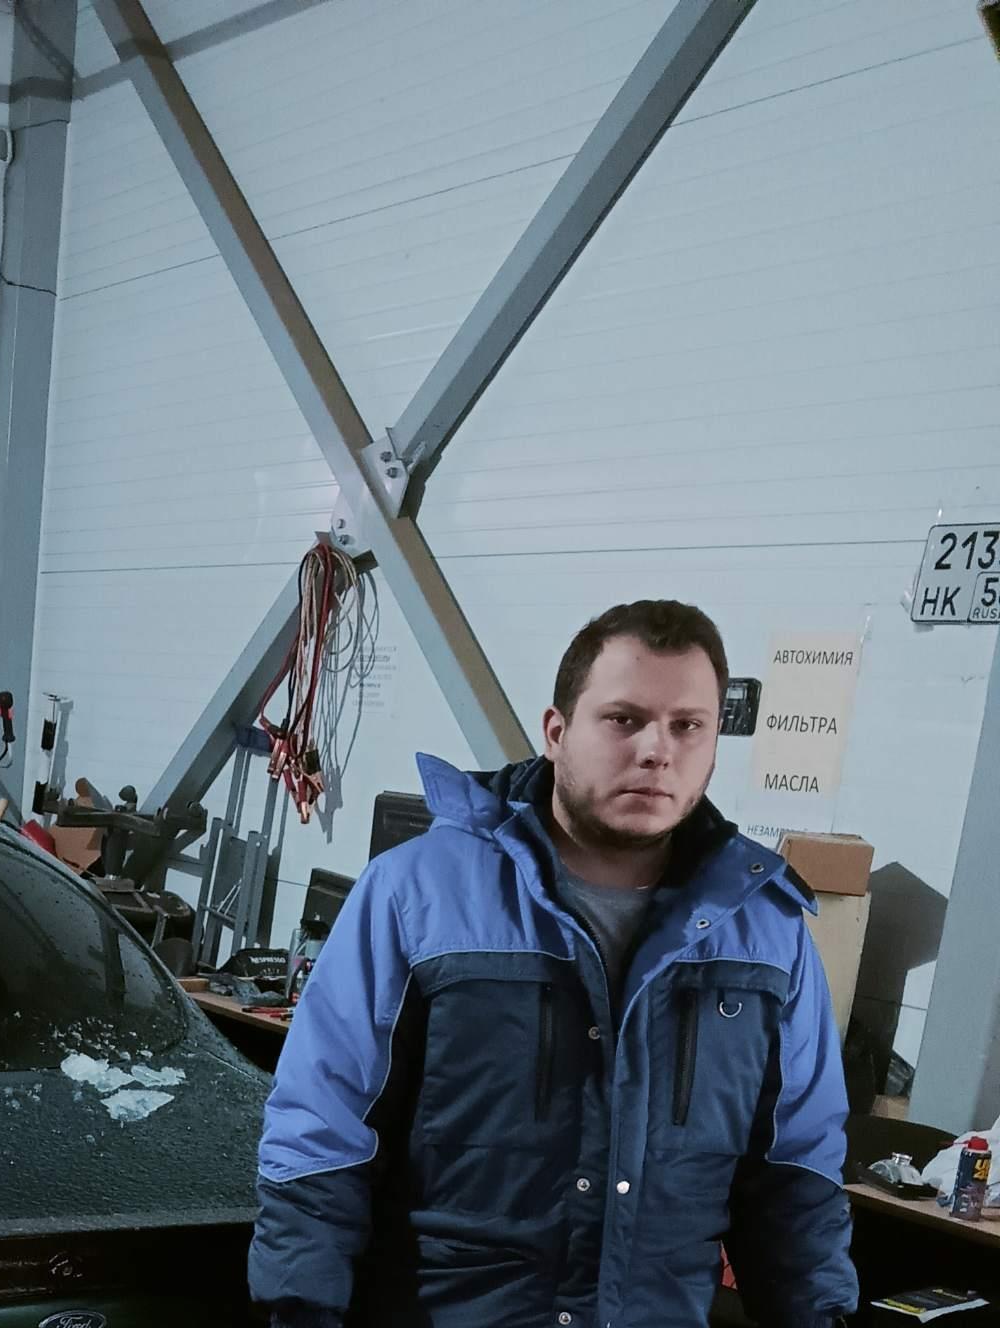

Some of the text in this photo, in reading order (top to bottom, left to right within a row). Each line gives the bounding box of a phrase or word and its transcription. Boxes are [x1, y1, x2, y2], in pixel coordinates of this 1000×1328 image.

[934, 531, 1000, 570] 213
[981, 577, 1000, 607] 5
[773, 649, 854, 666] АВТОХИМИЯ
[766, 713, 838, 735] ФИЛЬТРА
[764, 773, 820, 793] МАСЛА
